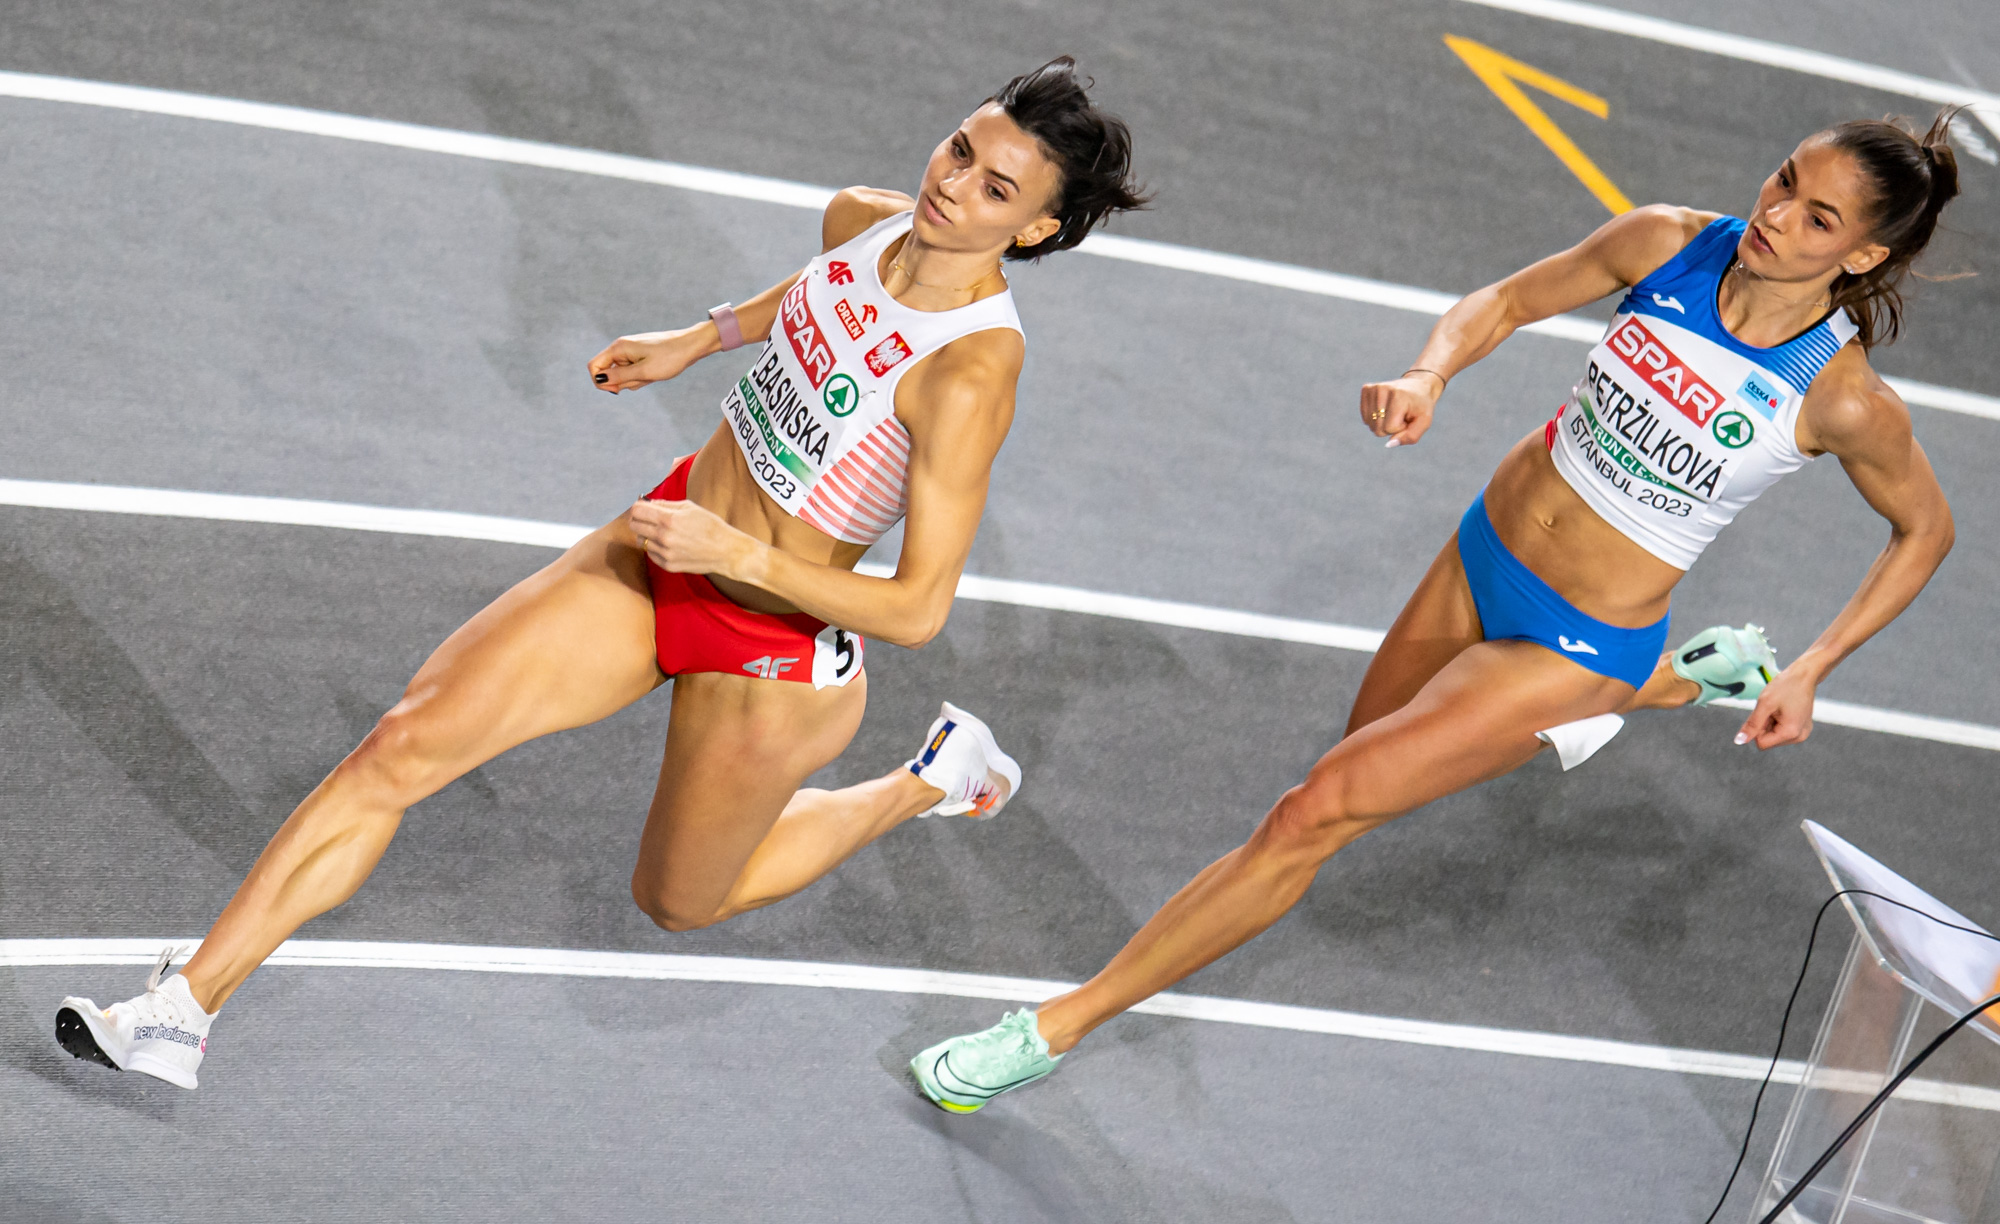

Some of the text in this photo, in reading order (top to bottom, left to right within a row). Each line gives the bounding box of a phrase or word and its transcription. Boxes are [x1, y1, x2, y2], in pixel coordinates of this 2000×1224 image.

[827, 260, 855, 286] 4F
[784, 283, 831, 383] SPAR
[837, 302, 862, 338] ORLEN
[1613, 324, 1716, 421] SPAR
[744, 383, 760, 414] RUN
[726, 387, 796, 500] TANBUL 2023
[1589, 361, 1727, 498] PETRŽILKOVÁ
[1593, 425, 1622, 457] RUN
[1570, 414, 1693, 518] ISTANBUL 2023
[742, 655, 800, 680] 4F
[134, 1023, 201, 1048] new balance
